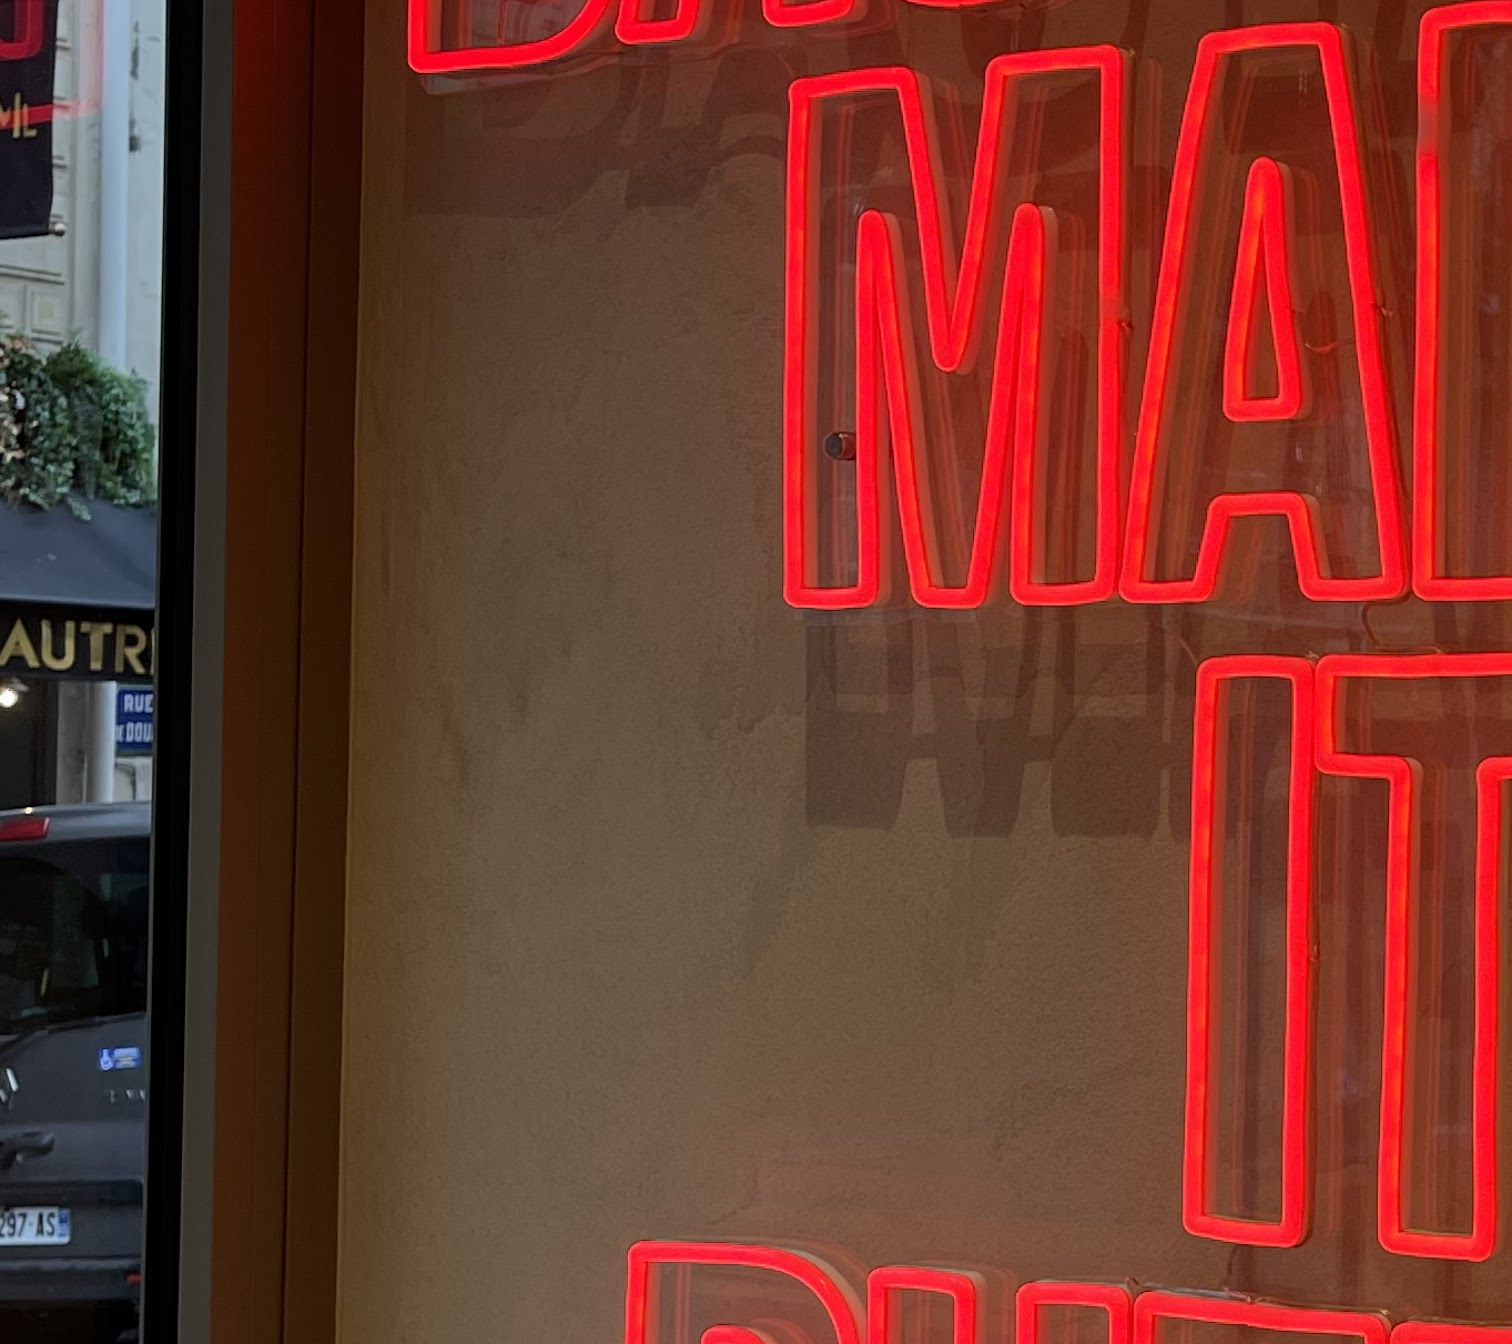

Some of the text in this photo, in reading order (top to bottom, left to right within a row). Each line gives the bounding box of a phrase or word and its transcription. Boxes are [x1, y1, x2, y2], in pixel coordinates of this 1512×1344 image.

[0, 618, 154, 676] AUTR
[124, 693, 153, 713] RUE
[126, 721, 154, 743] DOU
